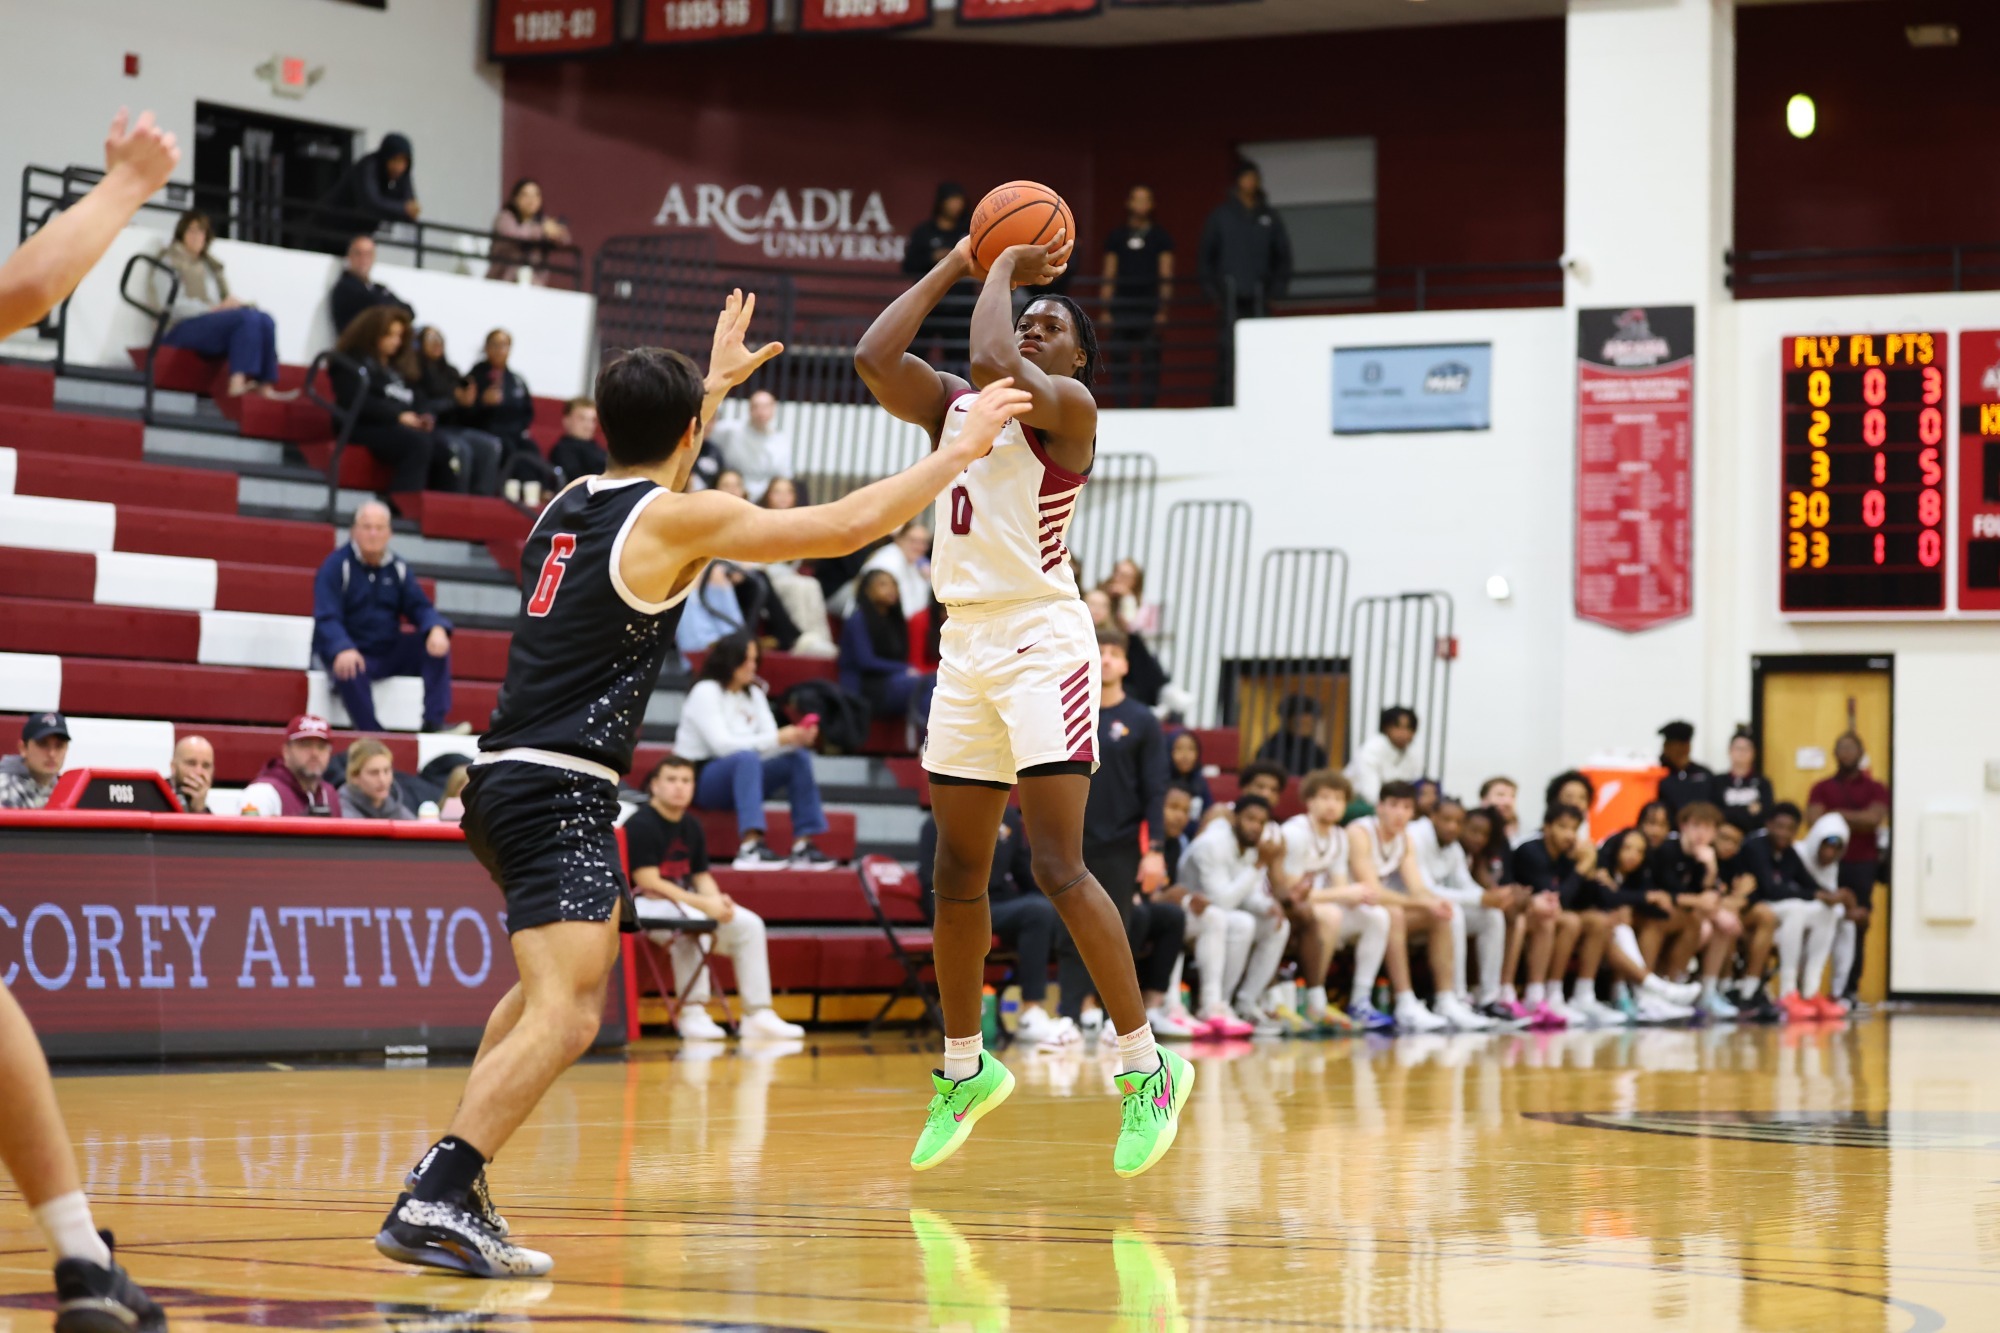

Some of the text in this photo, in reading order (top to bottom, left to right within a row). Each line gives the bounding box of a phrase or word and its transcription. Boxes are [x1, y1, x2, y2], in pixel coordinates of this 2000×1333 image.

[654, 183, 895, 245] ARCADIA
[1795, 332, 1934, 368] PLY FL PTS
[1808, 369, 1831, 407] 0
[1863, 367, 1887, 406] 0
[1922, 366, 1942, 405] 3
[1808, 409, 1831, 448] 2
[1863, 408, 1887, 447] 0
[1919, 407, 1942, 446] 0
[1811, 447, 1942, 488] 3 1 5
[950, 485, 974, 536] 0
[1788, 488, 1941, 529] 30 0 8
[1973, 513, 2000, 539] FO
[1788, 529, 1941, 569] 33 1 0
[527, 532, 577, 618] 6
[109, 784, 135, 804] POSS
[237, 906, 508, 988] ATTIVO
